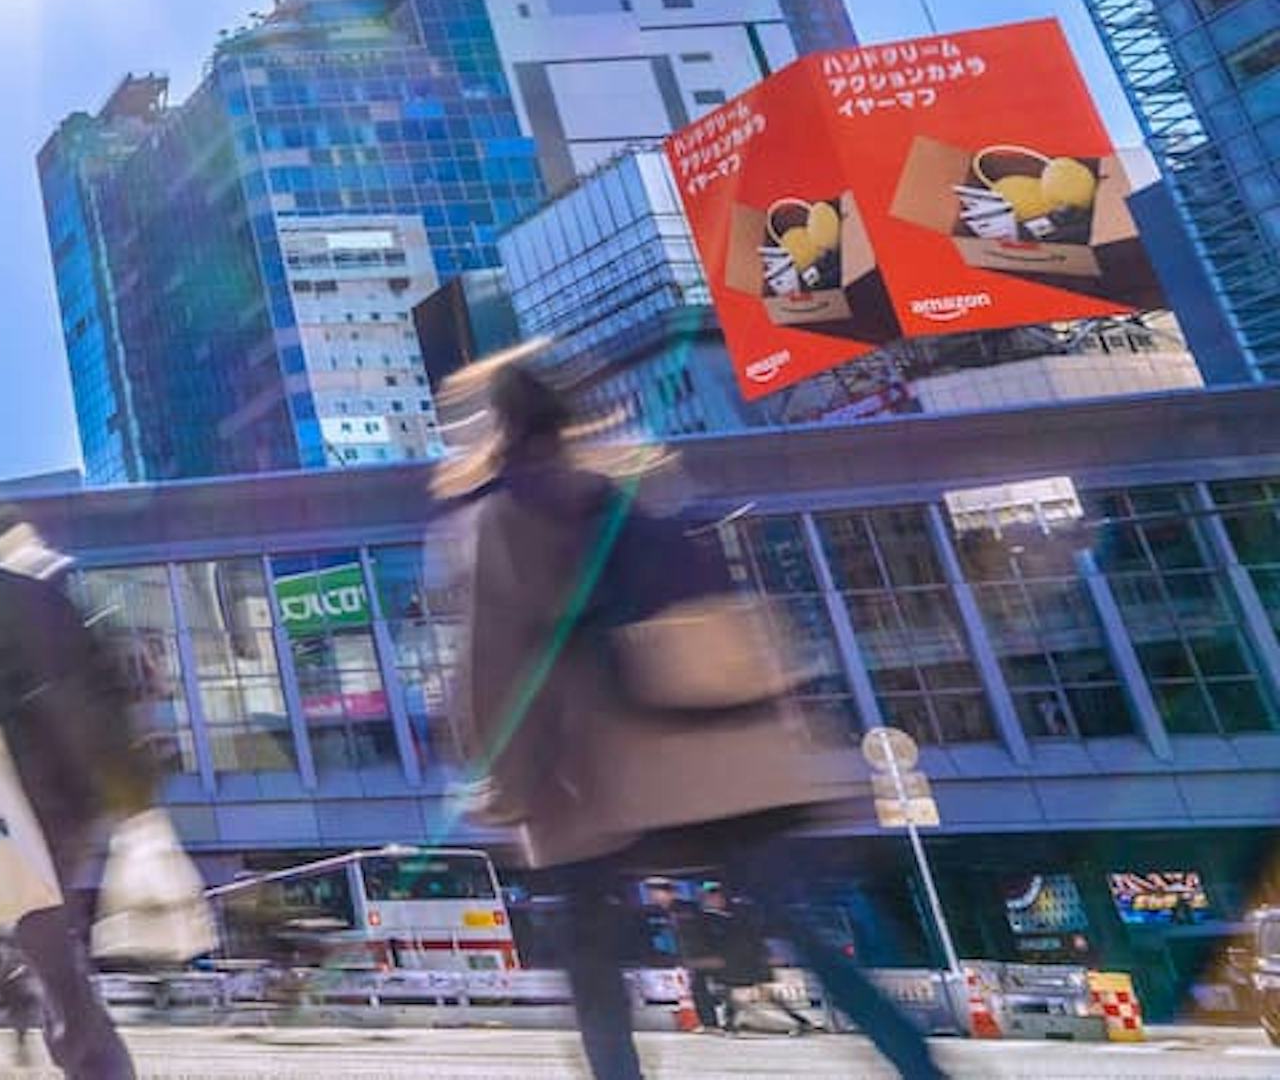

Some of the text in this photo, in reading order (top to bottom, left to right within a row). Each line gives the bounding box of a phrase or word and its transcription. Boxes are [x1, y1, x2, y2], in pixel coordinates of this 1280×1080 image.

[823, 39, 961, 76] ハンドクリーム
[828, 56, 986, 97] アクションカメラ
[838, 87, 937, 117] イヤーマフ
[910, 292, 992, 317] amazon
